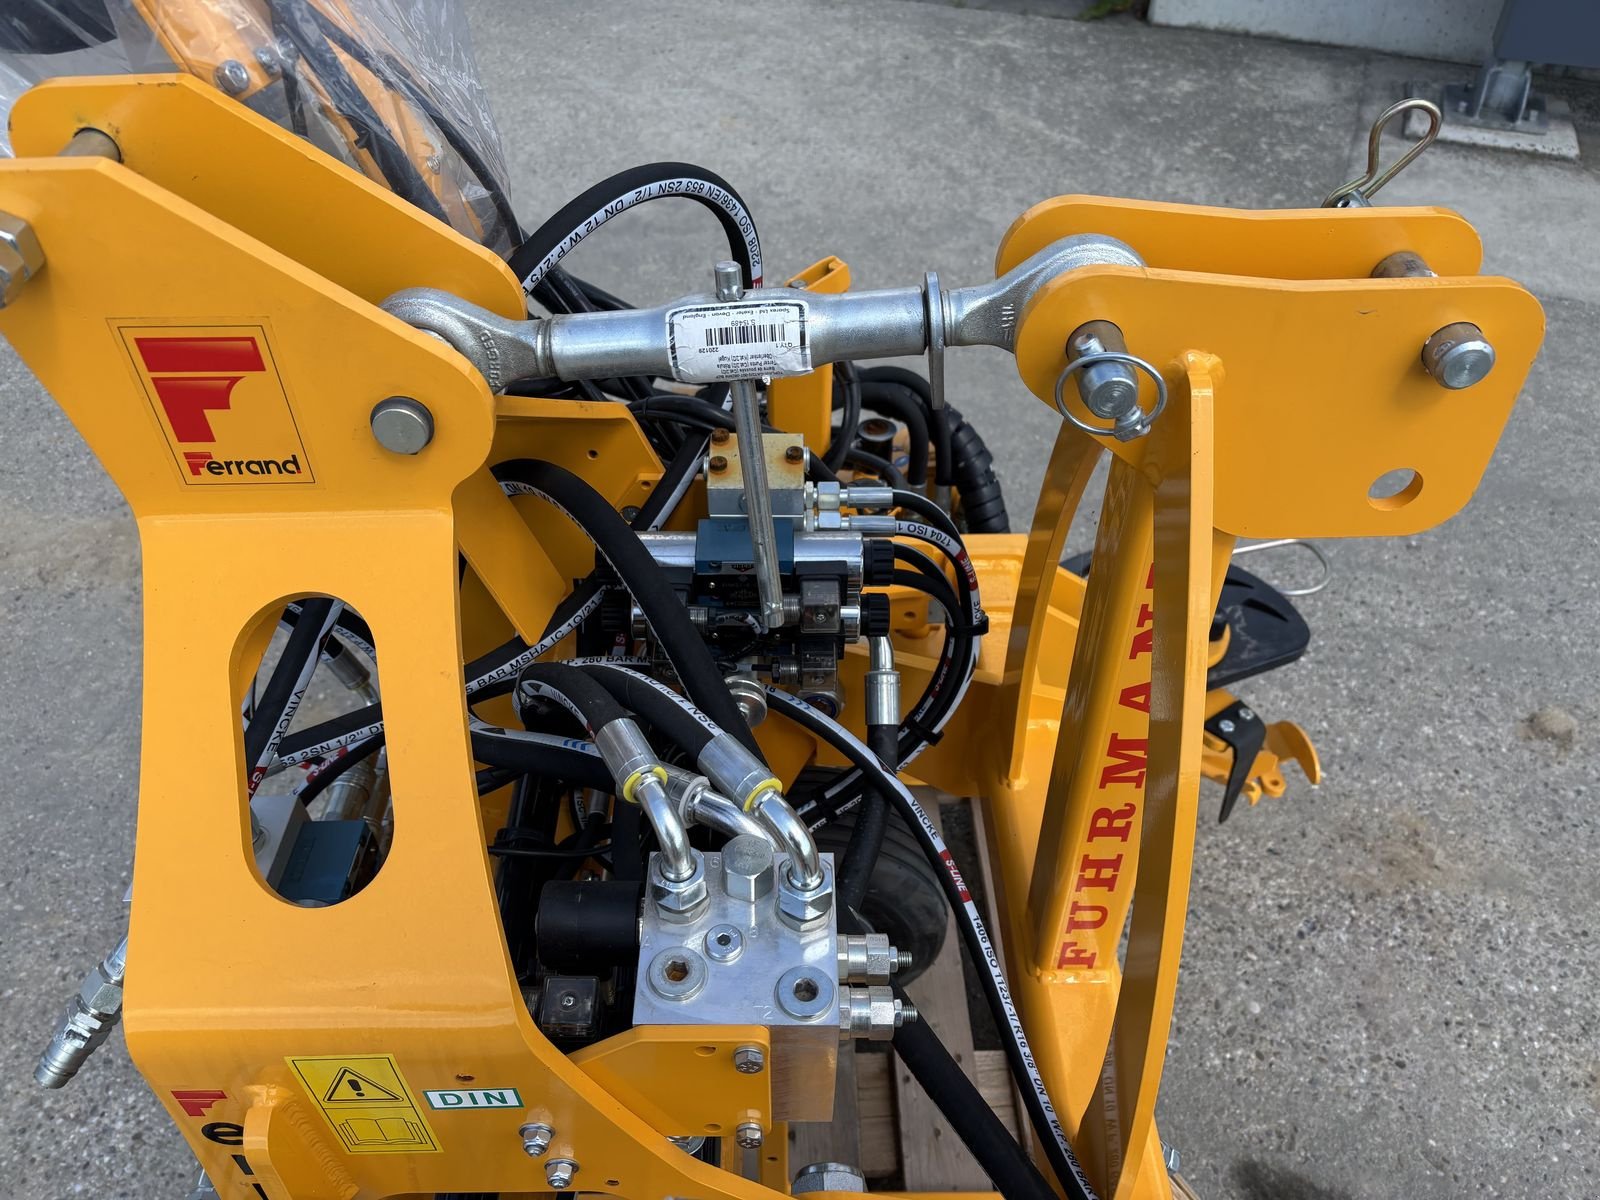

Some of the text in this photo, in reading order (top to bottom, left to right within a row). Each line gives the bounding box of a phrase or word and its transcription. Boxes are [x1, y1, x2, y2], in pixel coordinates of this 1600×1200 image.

[657, 180, 683, 195] 2SN
[685, 180, 706, 194] 853
[603, 199, 625, 220] DN
[706, 186, 744, 216] 1436/EN
[584, 215, 601, 233] 12
[739, 215, 754, 236] ISO
[748, 236, 761, 267] 2208
[682, 312, 707, 320] England
[183, 451, 302, 477] Ferrand
[907, 523, 928, 534] ISO
[930, 529, 951, 547] 1704
[477, 669, 508, 688] BAR
[511, 643, 549, 669] MSHA
[551, 630, 566, 644] IC
[266, 689, 305, 753] VINCKE
[300, 742, 330, 760] 2SN
[910, 799, 938, 840] VINCKE
[946, 859, 968, 892] S-LINE
[972, 914, 989, 943] 1406
[985, 945, 999, 970] ISO
[1033, 1077, 1048, 1096] DN
[1042, 1100, 1054, 1113] 10
[438, 1091, 509, 1106] DIN
